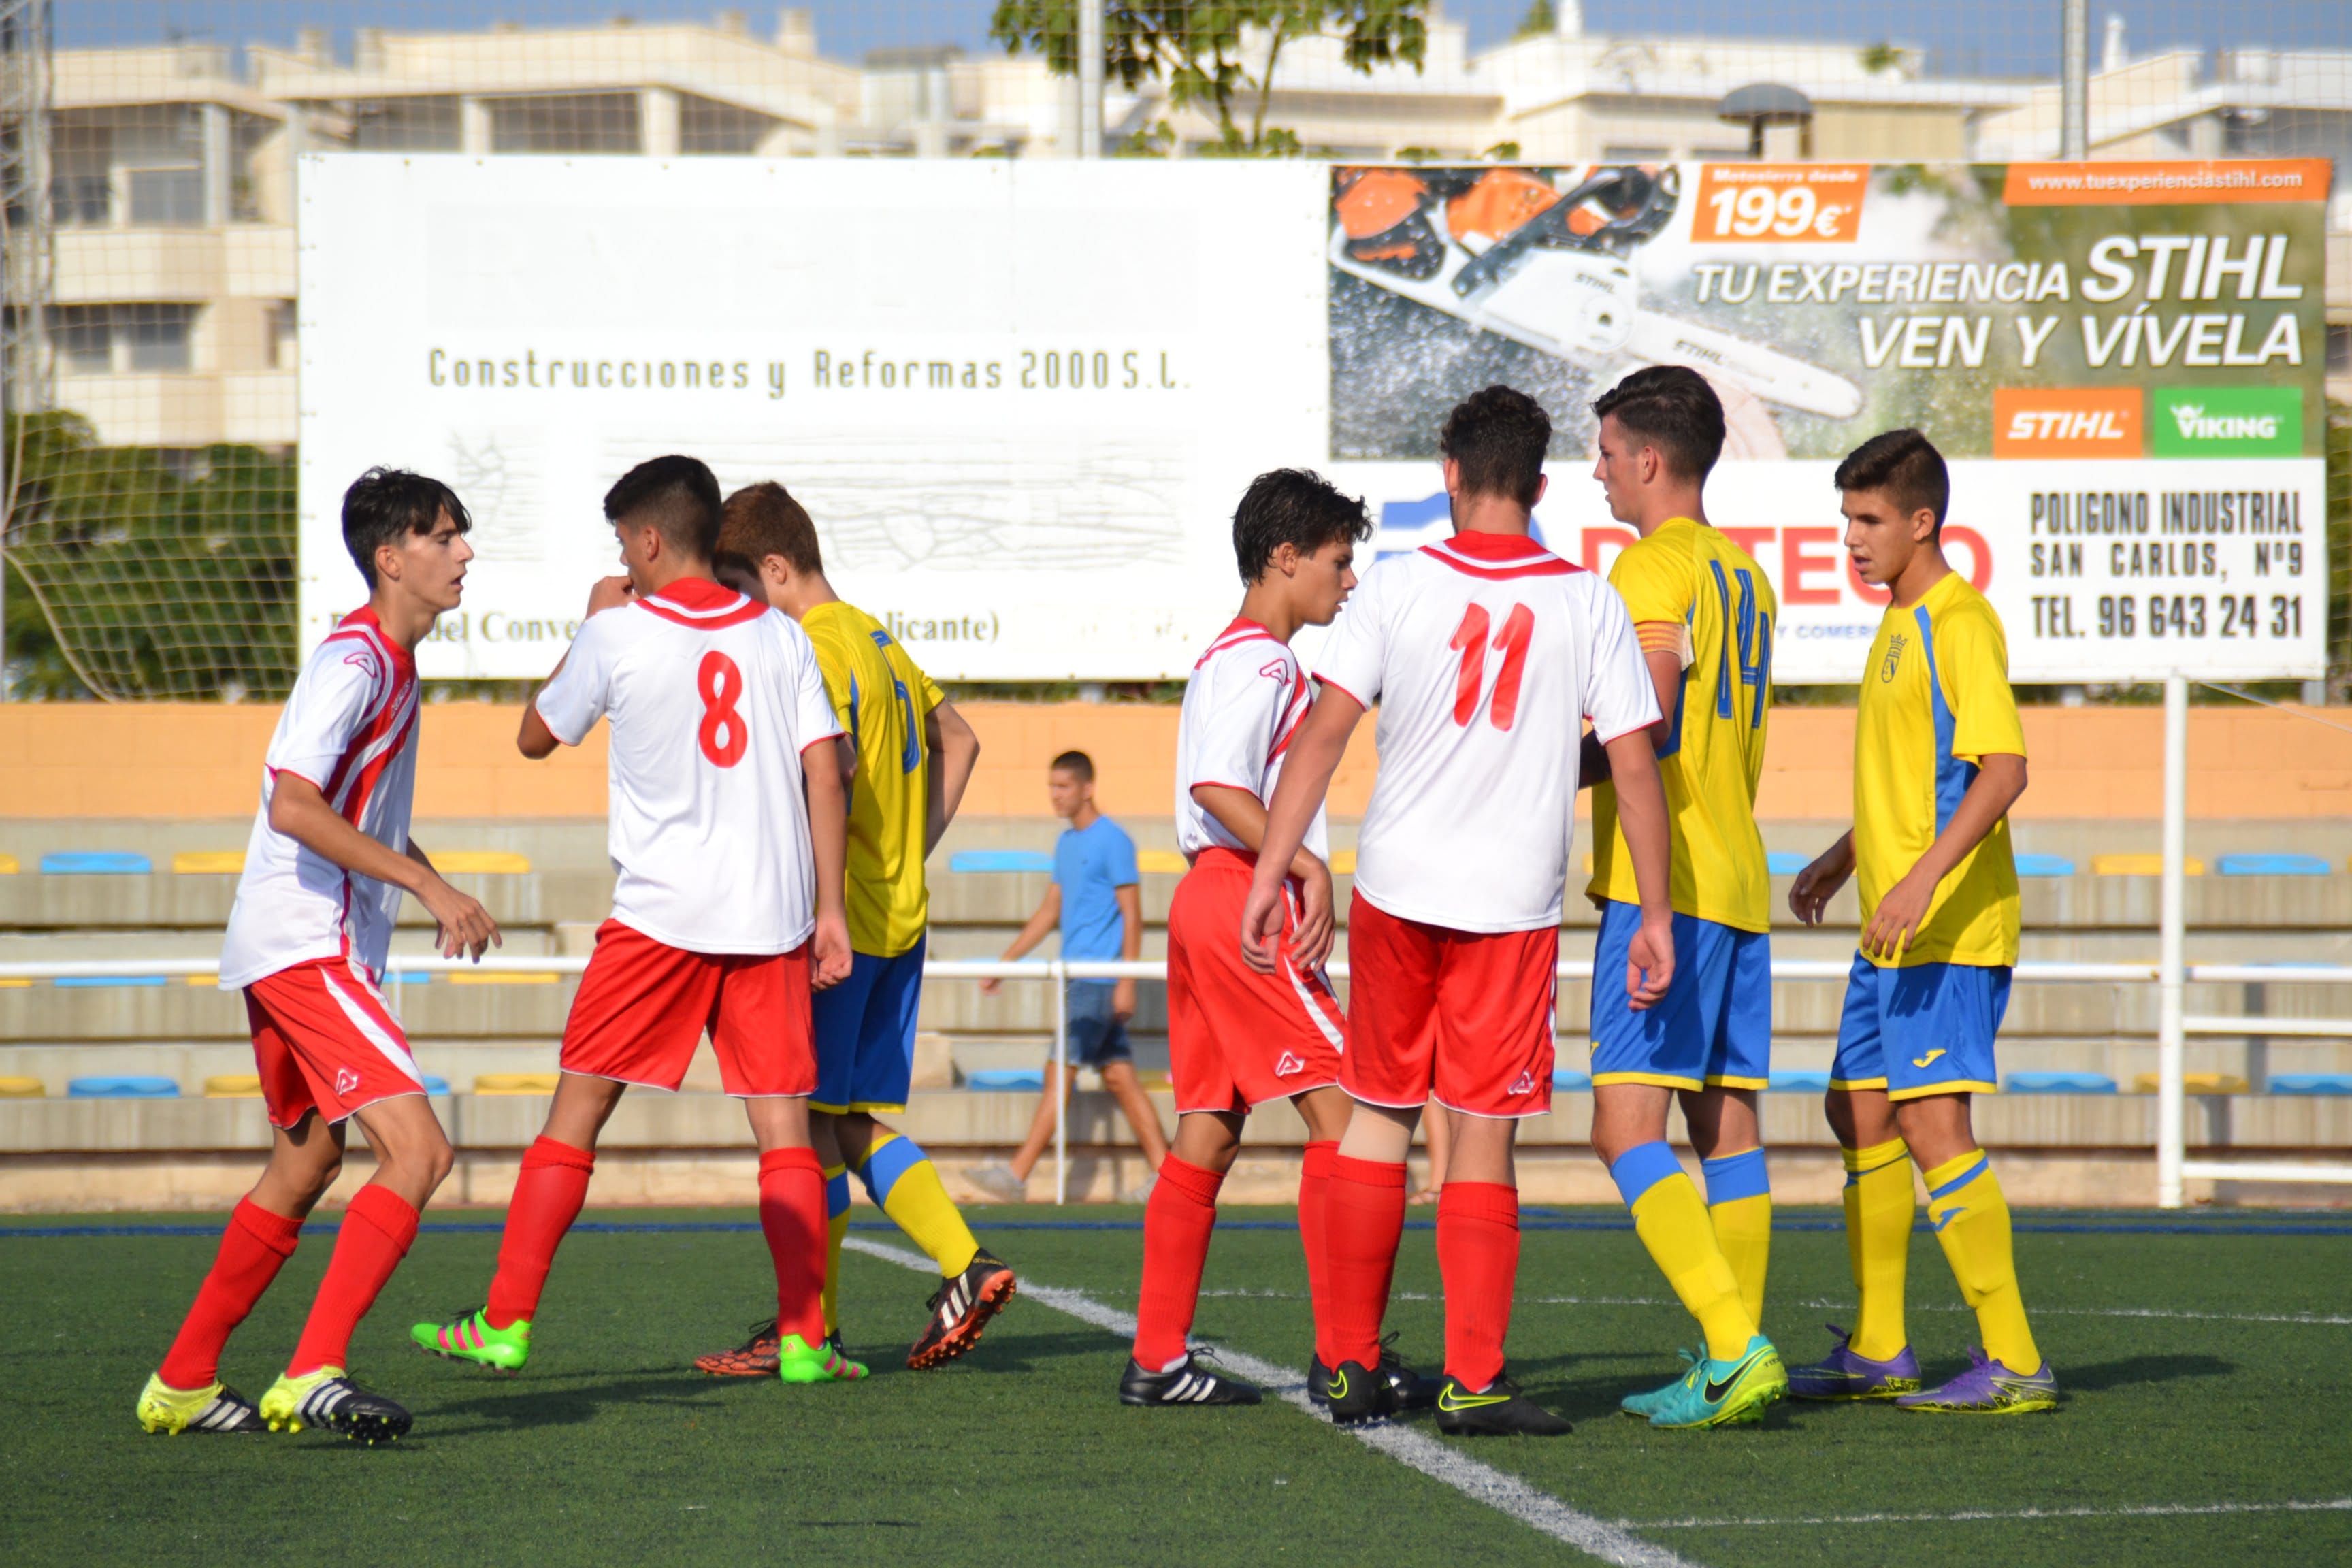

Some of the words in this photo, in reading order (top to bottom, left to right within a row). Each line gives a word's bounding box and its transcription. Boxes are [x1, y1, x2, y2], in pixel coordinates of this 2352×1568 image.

[2027, 169, 2303, 192] www.tuexperienciastihl.com
[1694, 261, 1758, 304] TU
[1767, 261, 2070, 304] EXPERIENCIA
[2081, 234, 2303, 301] STIHL
[1859, 316, 1992, 368] VEN
[2015, 316, 2060, 368] Y
[2081, 304, 2303, 368] VÍVELA
[429, 347, 750, 389] Construcciones
[768, 361, 786, 400] y
[813, 348, 1002, 389] Reformas
[1019, 348, 1110, 389] 2000
[1121, 348, 1191, 389] S.L.
[2008, 411, 2125, 440] STIHL
[2177, 416, 2277, 439] VIKING
[2031, 490, 2149, 535] POLIGONO
[2160, 490, 2303, 535] INDUSTRIAL
[2030, 542, 2083, 576] SAN
[2110, 542, 2228, 583] CARLOS,
[480, 612, 580, 643] Conve
[885, 610, 999, 645] licante)
[1795, 623, 1880, 640] COMER
[2031, 595, 2086, 638] TEL.
[2097, 594, 2136, 638] 96
[2148, 594, 2207, 638] 643
[2219, 594, 2258, 638] 24
[2270, 594, 2302, 638] 31
[1709, 559, 1769, 729] 14
[1449, 602, 1535, 733] 11
[698, 650, 748, 768] 8
